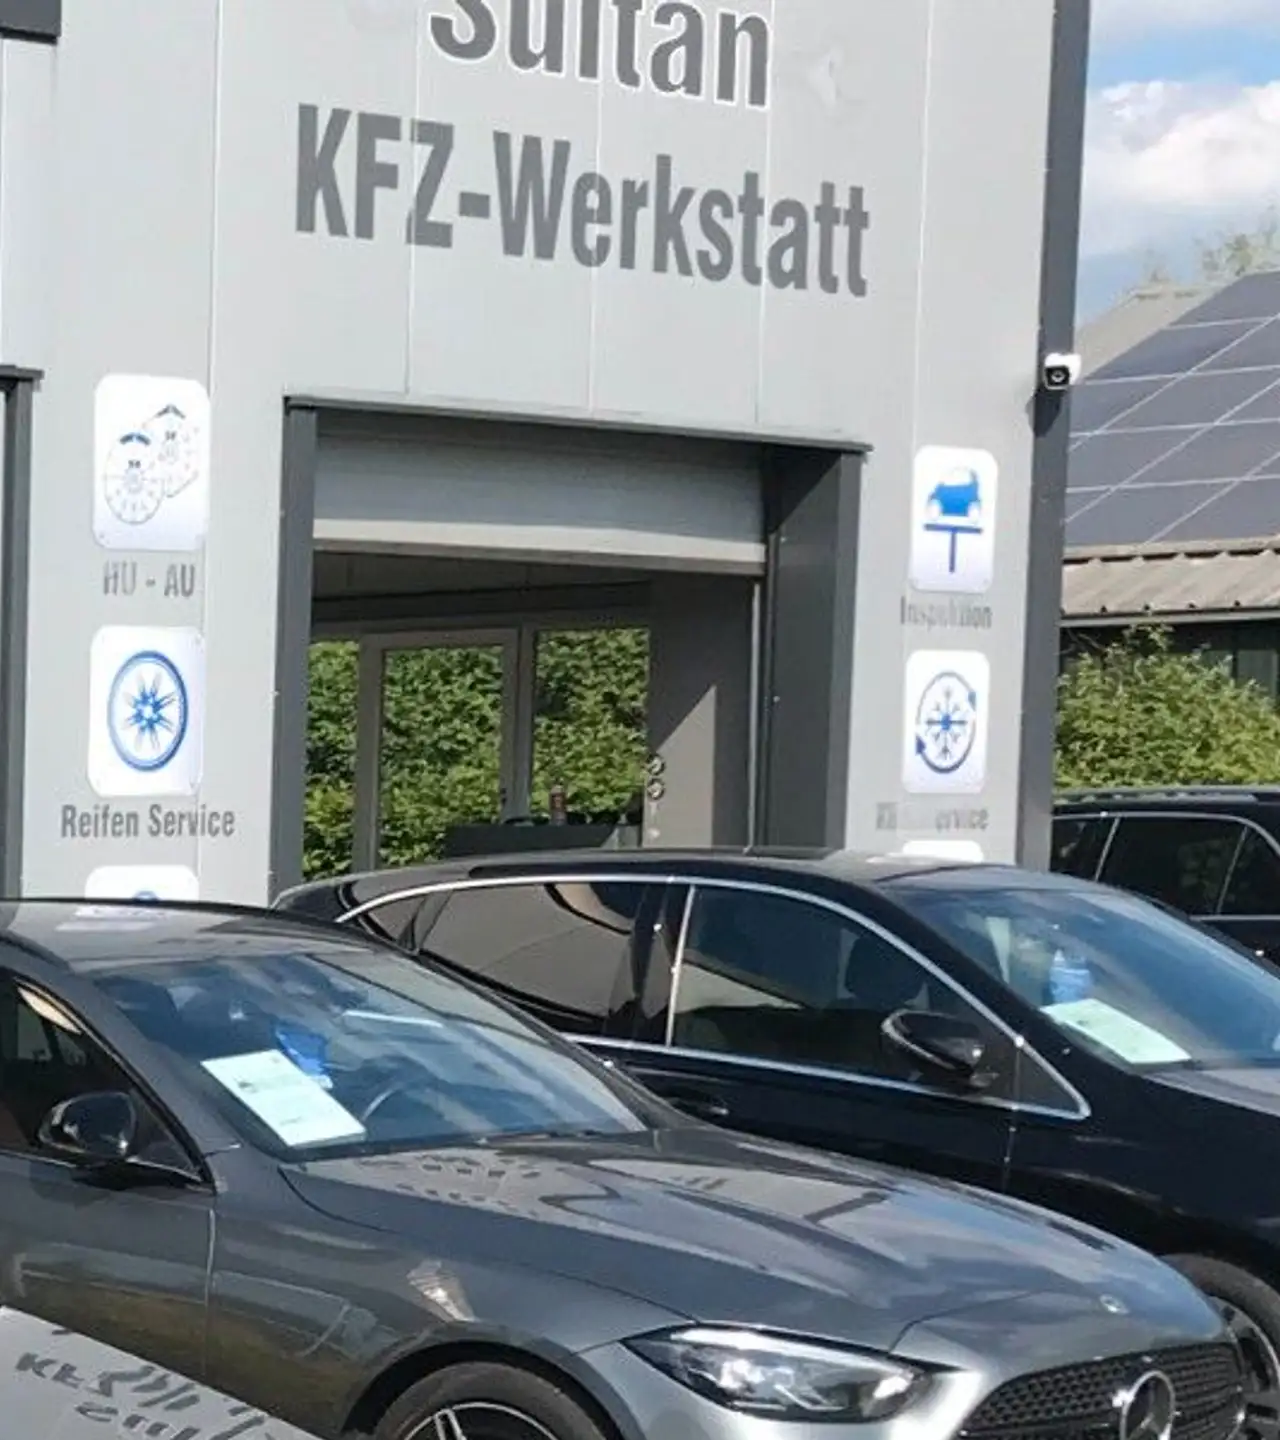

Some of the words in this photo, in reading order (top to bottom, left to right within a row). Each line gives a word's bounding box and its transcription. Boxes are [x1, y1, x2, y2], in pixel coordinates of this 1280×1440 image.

[295, 103, 870, 298] KFZ-Werkstatt
[103, 560, 138, 596] HU
[164, 563, 196, 597] AU
[61, 804, 140, 839] Reifen
[148, 802, 236, 838] Service
